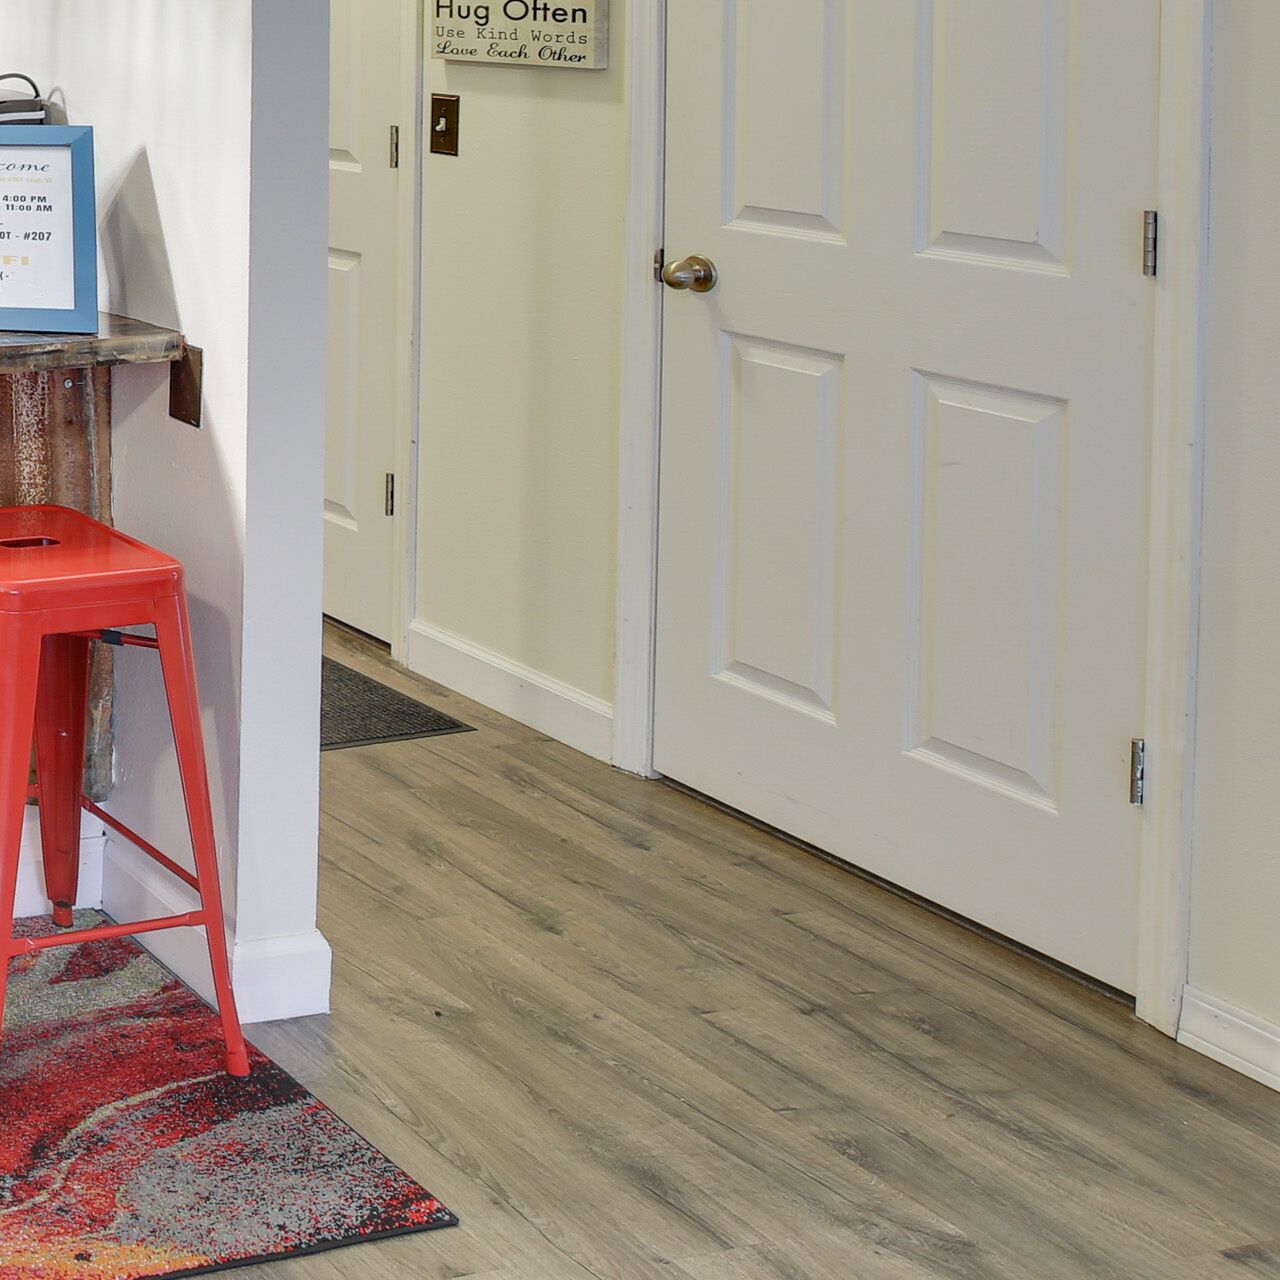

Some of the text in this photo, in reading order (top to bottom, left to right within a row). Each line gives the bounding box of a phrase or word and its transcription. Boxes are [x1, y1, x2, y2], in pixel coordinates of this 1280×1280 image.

[436, 26, 588, 44] Use Kind Words
[437, 40, 587, 63] Love Each Other
[24, 232, 52, 240] #207
